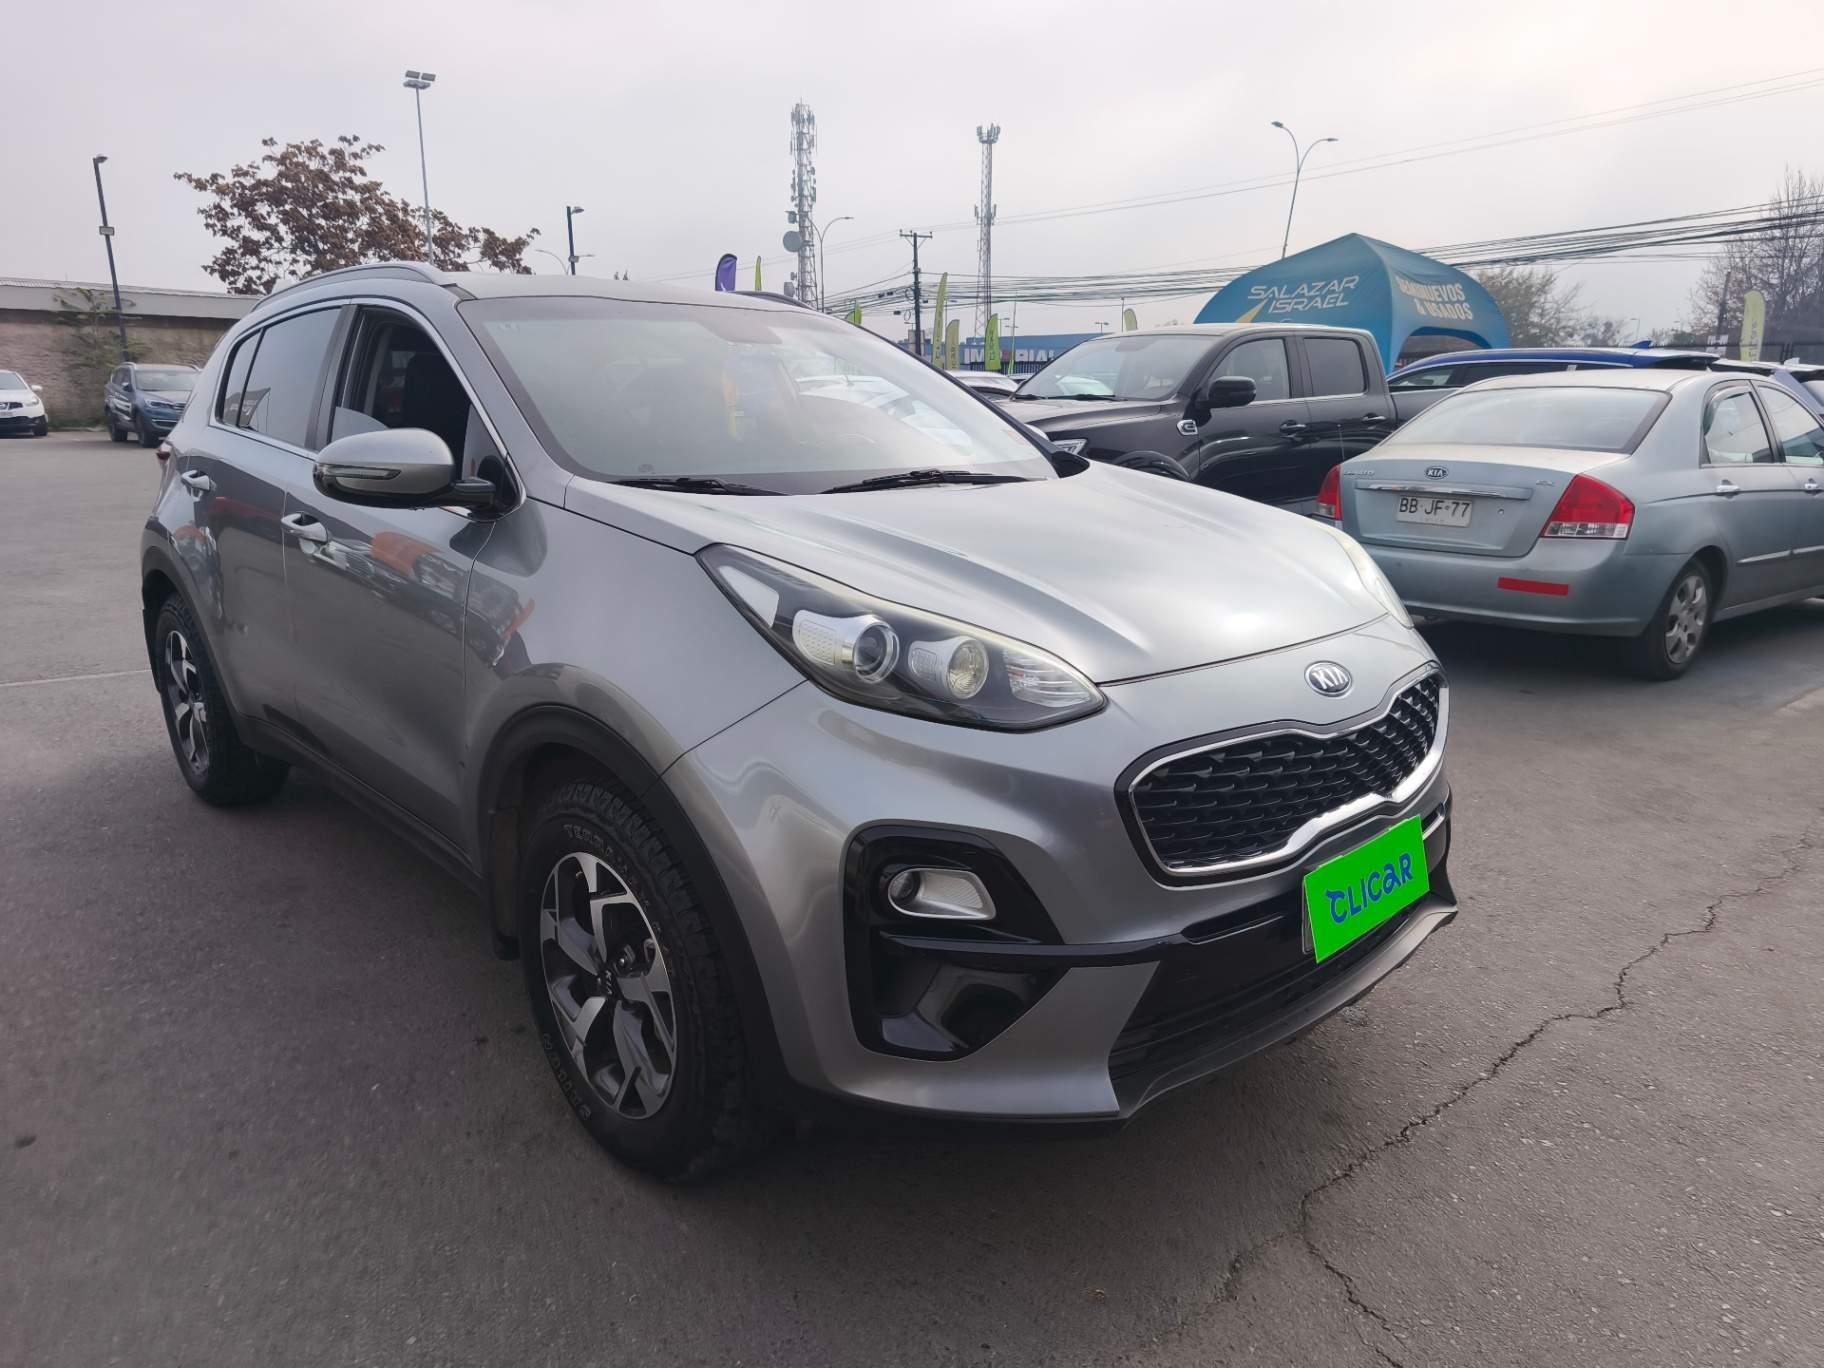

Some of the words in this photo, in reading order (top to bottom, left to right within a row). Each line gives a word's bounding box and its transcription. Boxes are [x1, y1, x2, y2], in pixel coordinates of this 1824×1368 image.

[1247, 275, 1360, 300] SALAZAR
[1395, 275, 1466, 302] UEVOS
[1268, 292, 1349, 314] ISRAEL
[1312, 667, 1348, 690] KIA
